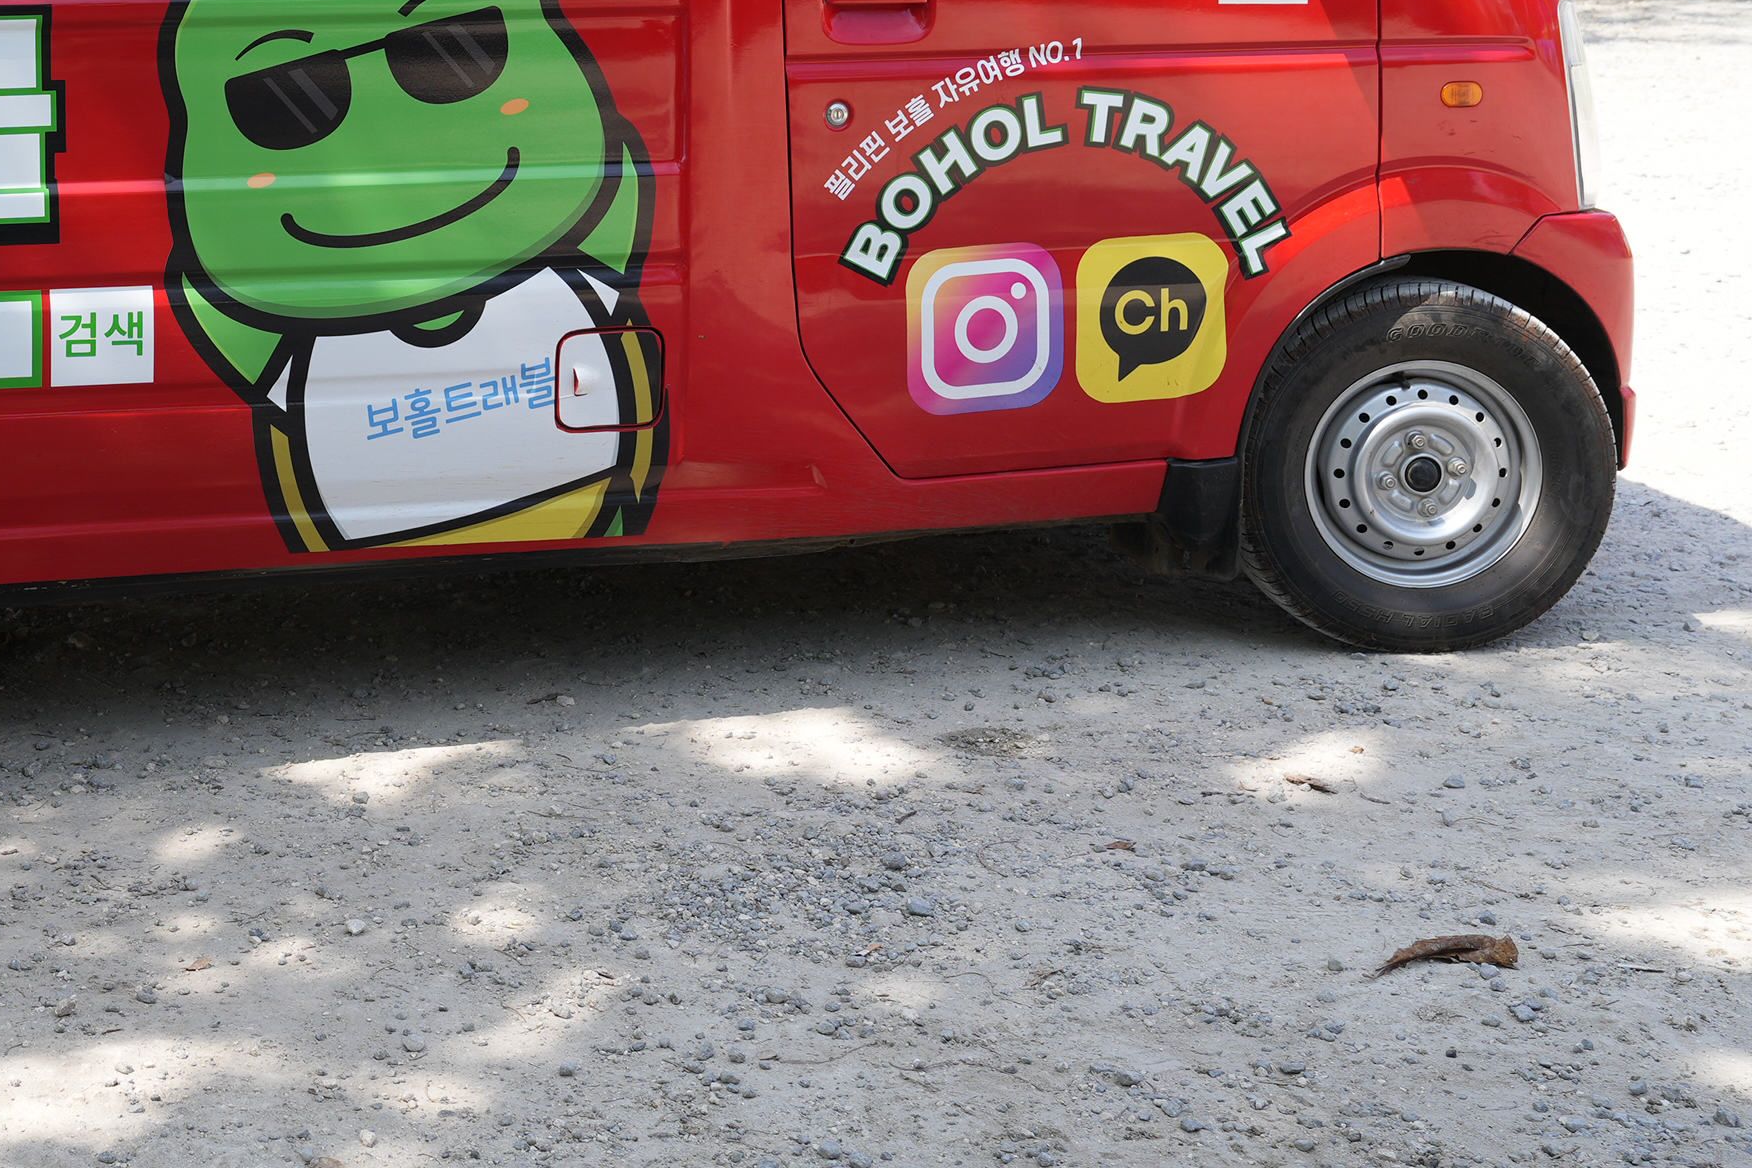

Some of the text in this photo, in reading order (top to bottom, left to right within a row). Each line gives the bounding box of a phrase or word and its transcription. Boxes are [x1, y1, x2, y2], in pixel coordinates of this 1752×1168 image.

[823, 37, 1084, 201] 필리핀 보홀 자유여행 NO.1
[842, 88, 1289, 282] BOHOL TRAVEL
[59, 310, 146, 360] 검색
[1114, 287, 1188, 335] Ch
[1386, 322, 1542, 369] GOODRIDE
[366, 357, 556, 441] 보홀트래블
[1401, 601, 1494, 629] RADIAL
